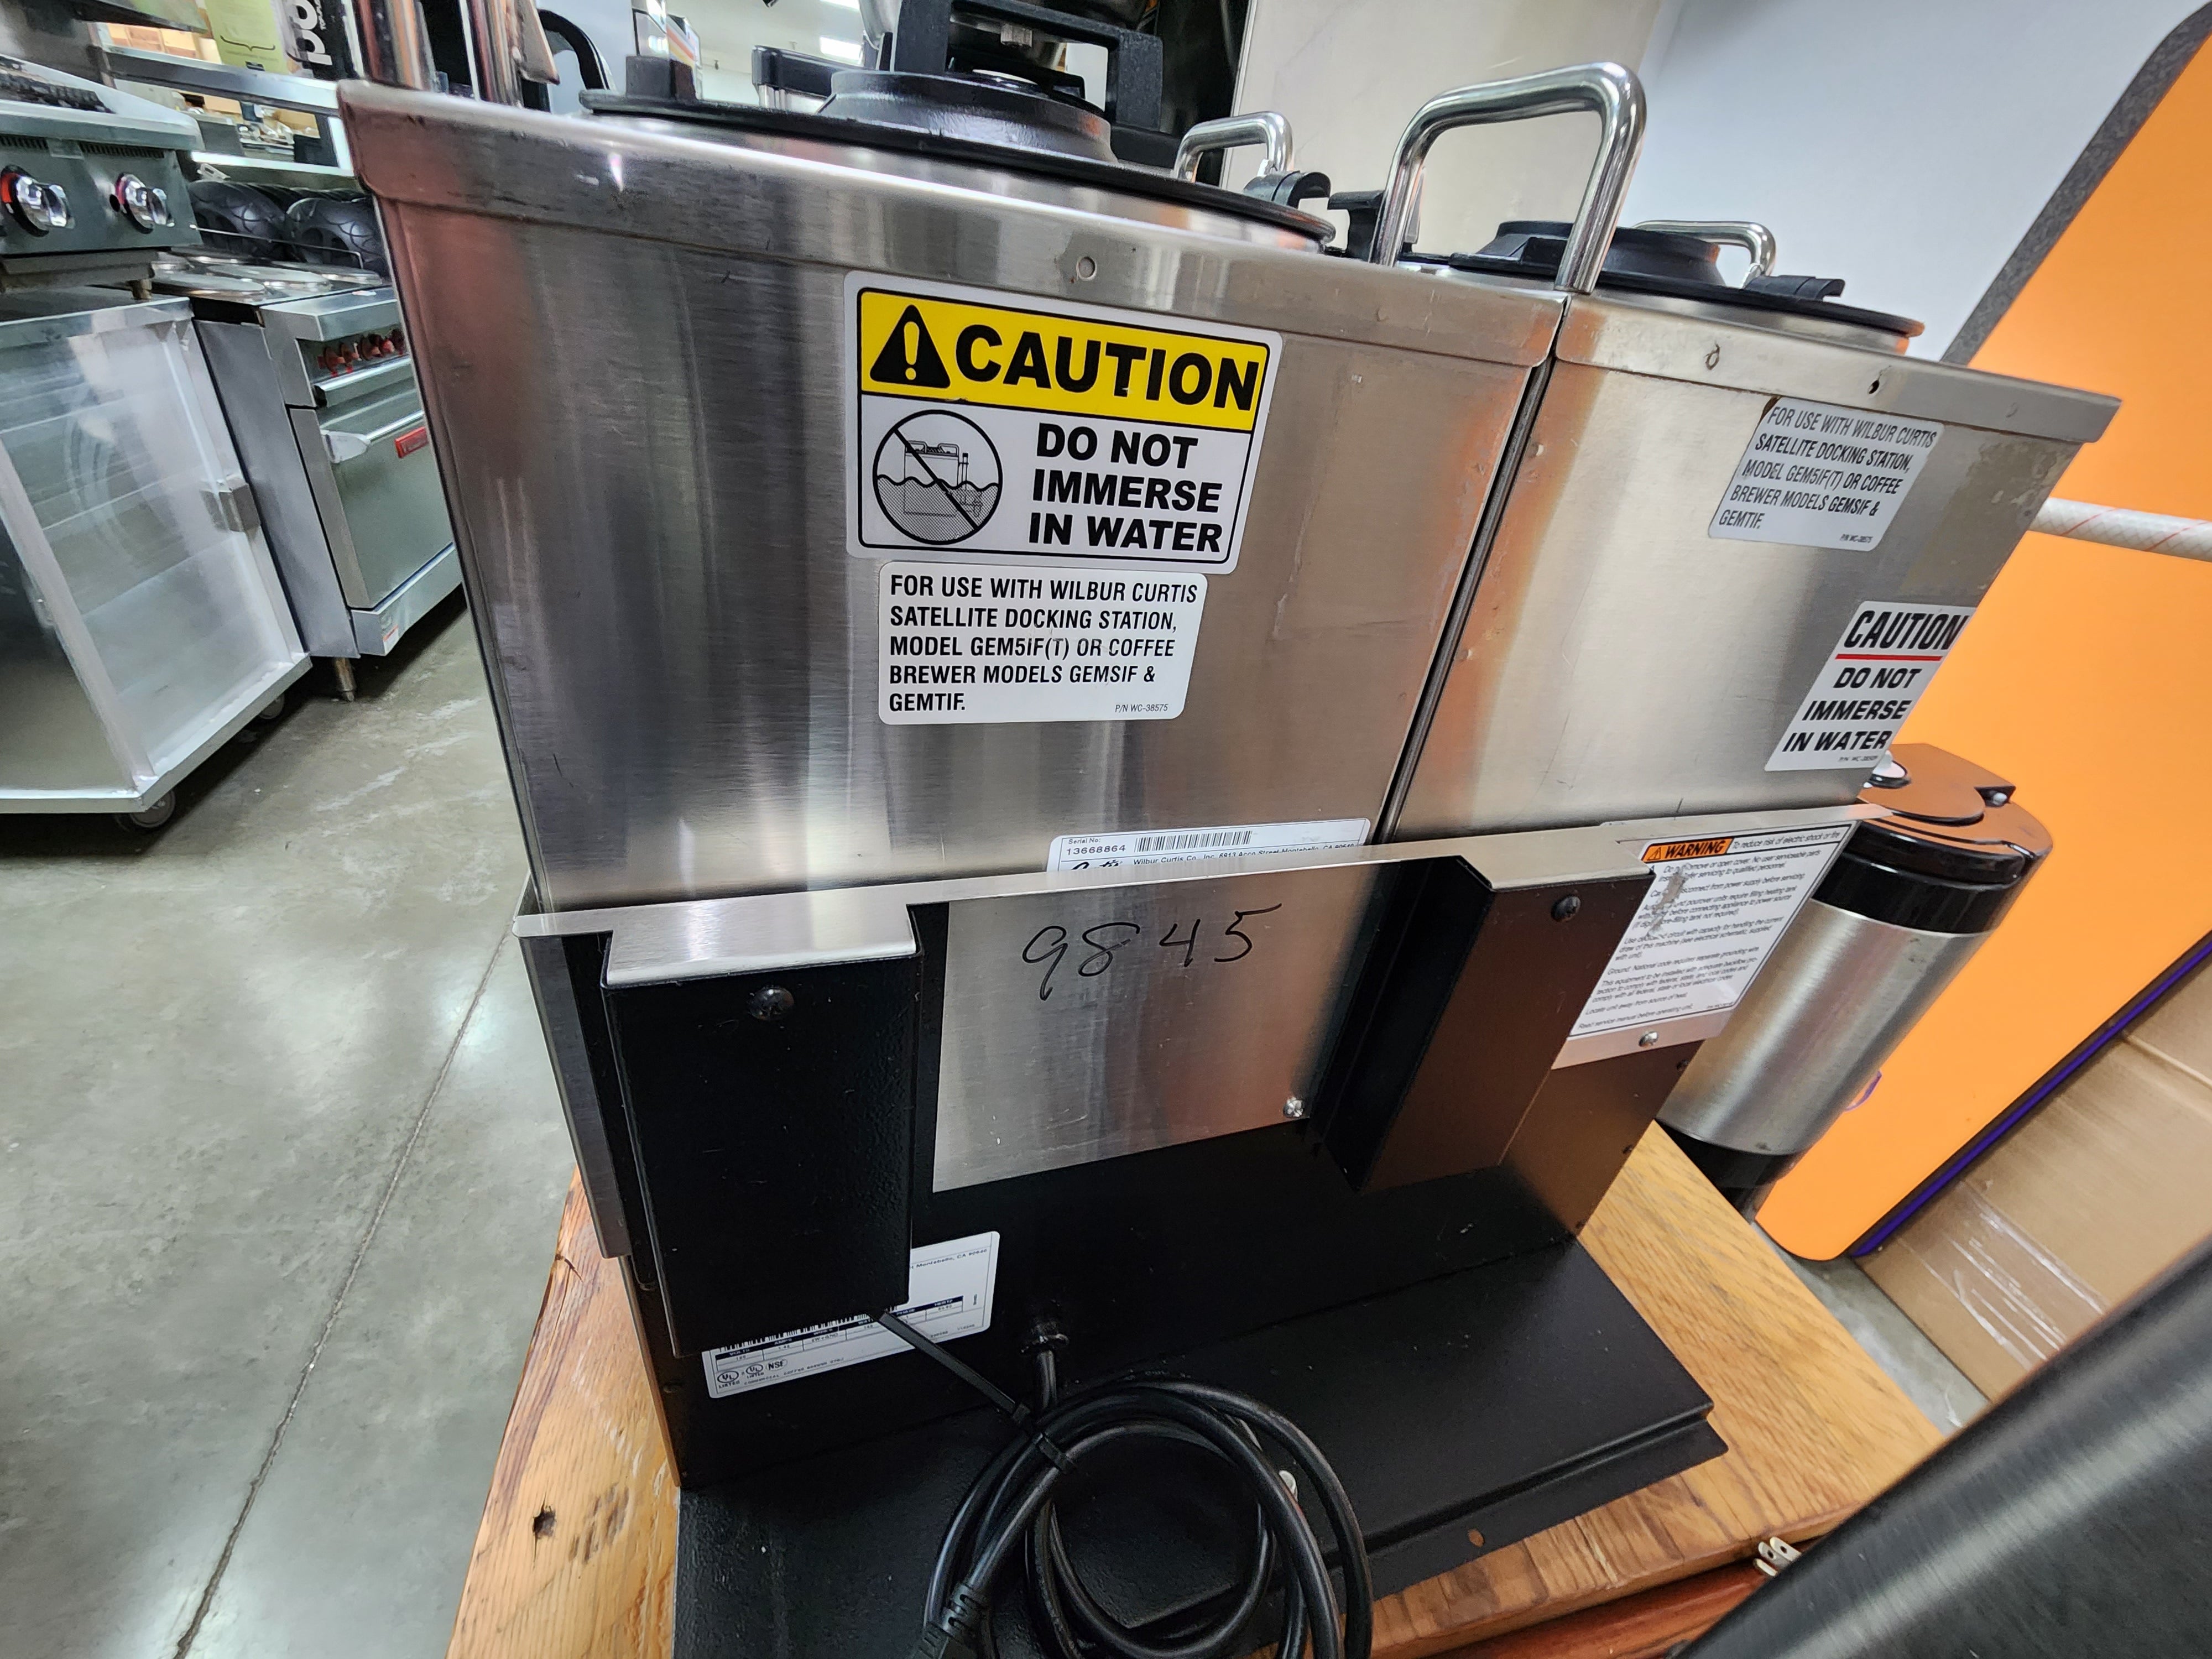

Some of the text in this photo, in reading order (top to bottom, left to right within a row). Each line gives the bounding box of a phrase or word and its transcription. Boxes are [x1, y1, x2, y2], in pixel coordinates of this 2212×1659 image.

[956, 324, 1261, 411] CAUTION
[1767, 406, 1937, 448] FOR USE WITH WILBUR CURTIS
[1036, 422, 1198, 468] DO NOT
[1755, 433, 1913, 473] SATELLITE DOCKING STATION,
[1742, 459, 1903, 494] MODEL GEM5IF(T) OR COFFEE
[1032, 468, 1223, 513] IMMERSE
[1730, 485, 1781, 506] BREWER
[1780, 492, 1828, 510] MODELS
[1869, 502, 1880, 517] &
[1029, 512, 1223, 552] IN WATER
[1719, 510, 1765, 529] GEMTIF.
[890, 574, 1197, 603] FOR USE WITH WILBUR CURTIS
[890, 606, 1177, 633] SATELLITE DOCKING STATION,
[1843, 610, 1970, 650] CAUTION
[890, 636, 1175, 660] MODEL GEM5IF(T) OR COFFEE
[890, 665, 1155, 684] BREWER MODELS GEMSIF &
[1833, 667, 1922, 688] DO NOT
[889, 692, 966, 711] GEMTIF.
[1114, 703, 1168, 713] P/N WC-38575
[1802, 700, 1912, 721] IMMERSE
[1782, 731, 1892, 752] IN WATER
[1067, 844, 1126, 855] 13668864
[1663, 839, 1728, 859] WARNING
[1022, 902, 1282, 1001] 9845
[768, 1360, 784, 1370] NSF
